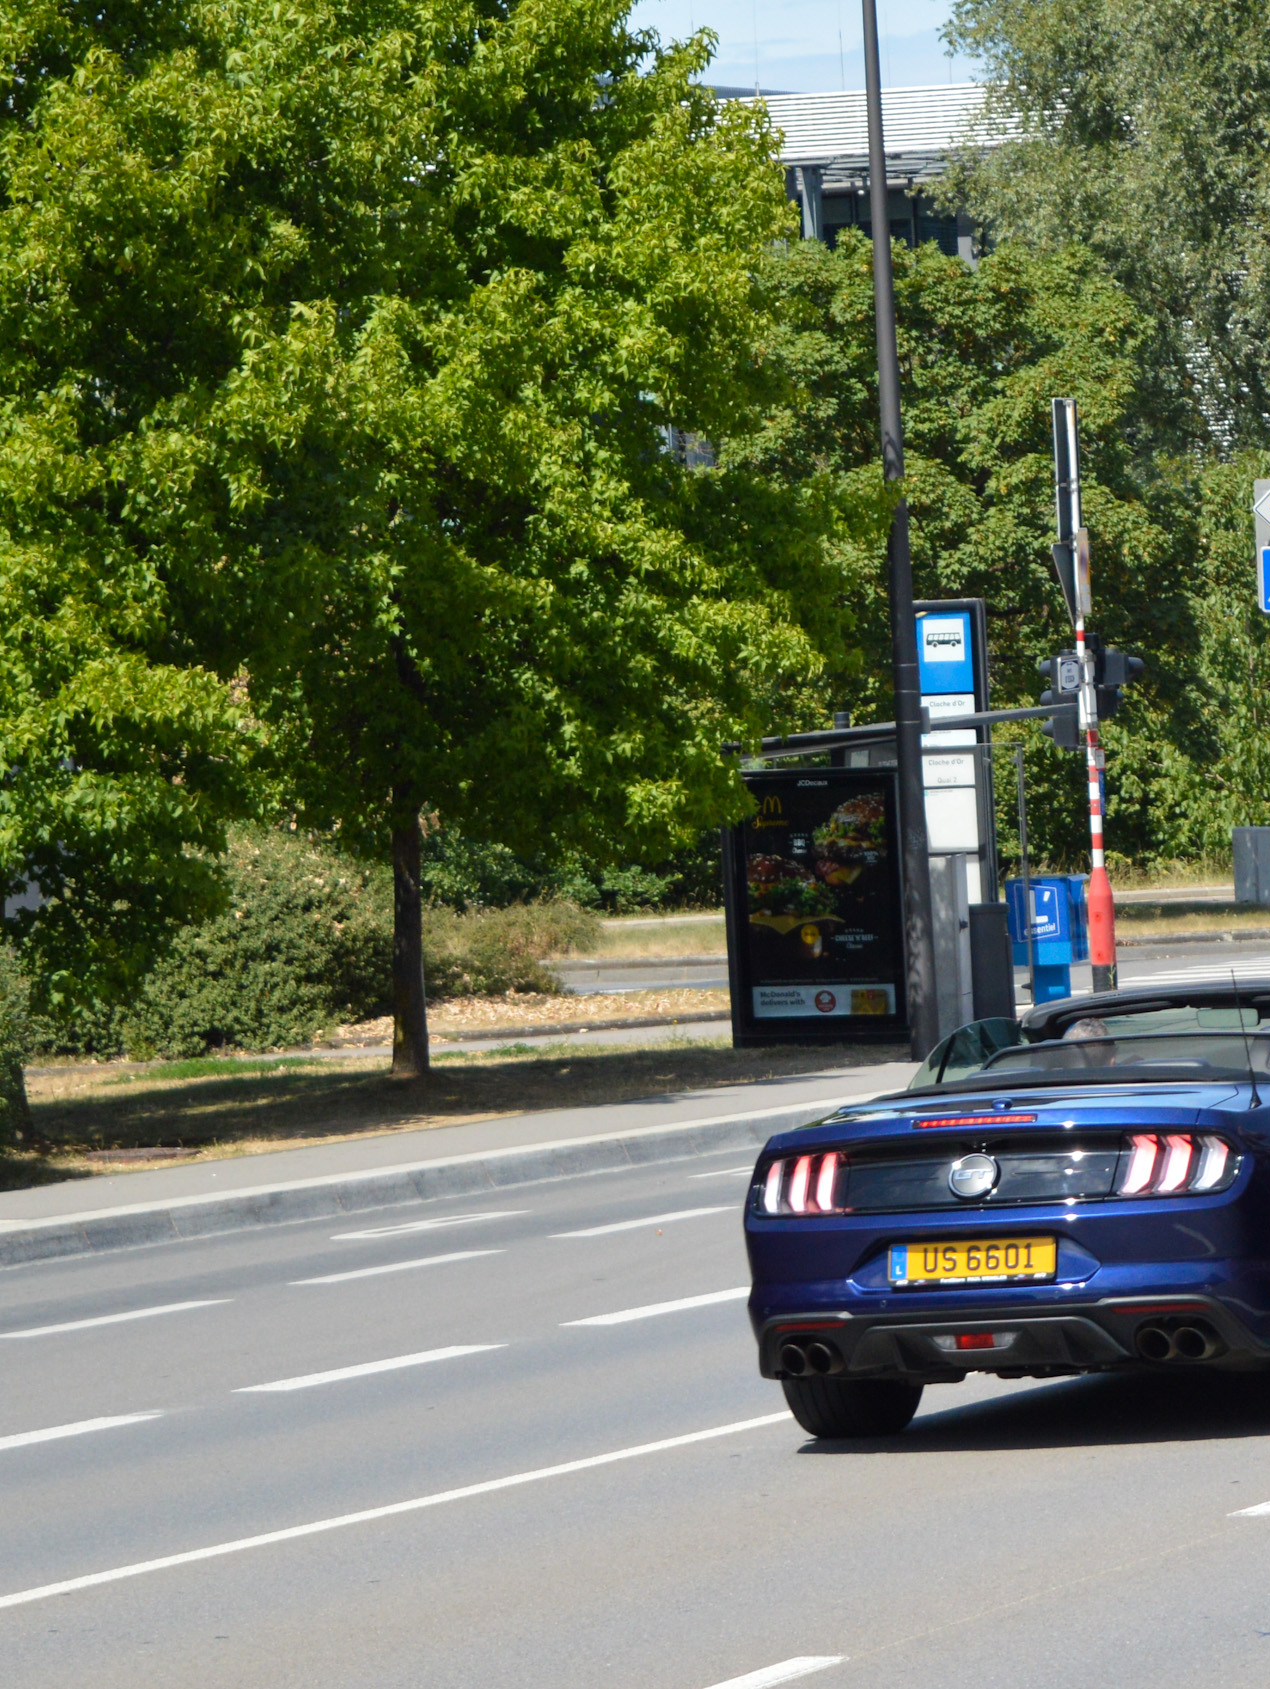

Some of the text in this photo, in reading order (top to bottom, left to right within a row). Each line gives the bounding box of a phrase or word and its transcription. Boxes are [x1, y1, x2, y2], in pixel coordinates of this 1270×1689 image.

[760, 990, 801, 998] McDonald's
[955, 1168, 992, 1180] GT
[896, 1242, 1034, 1275] L US 6601
